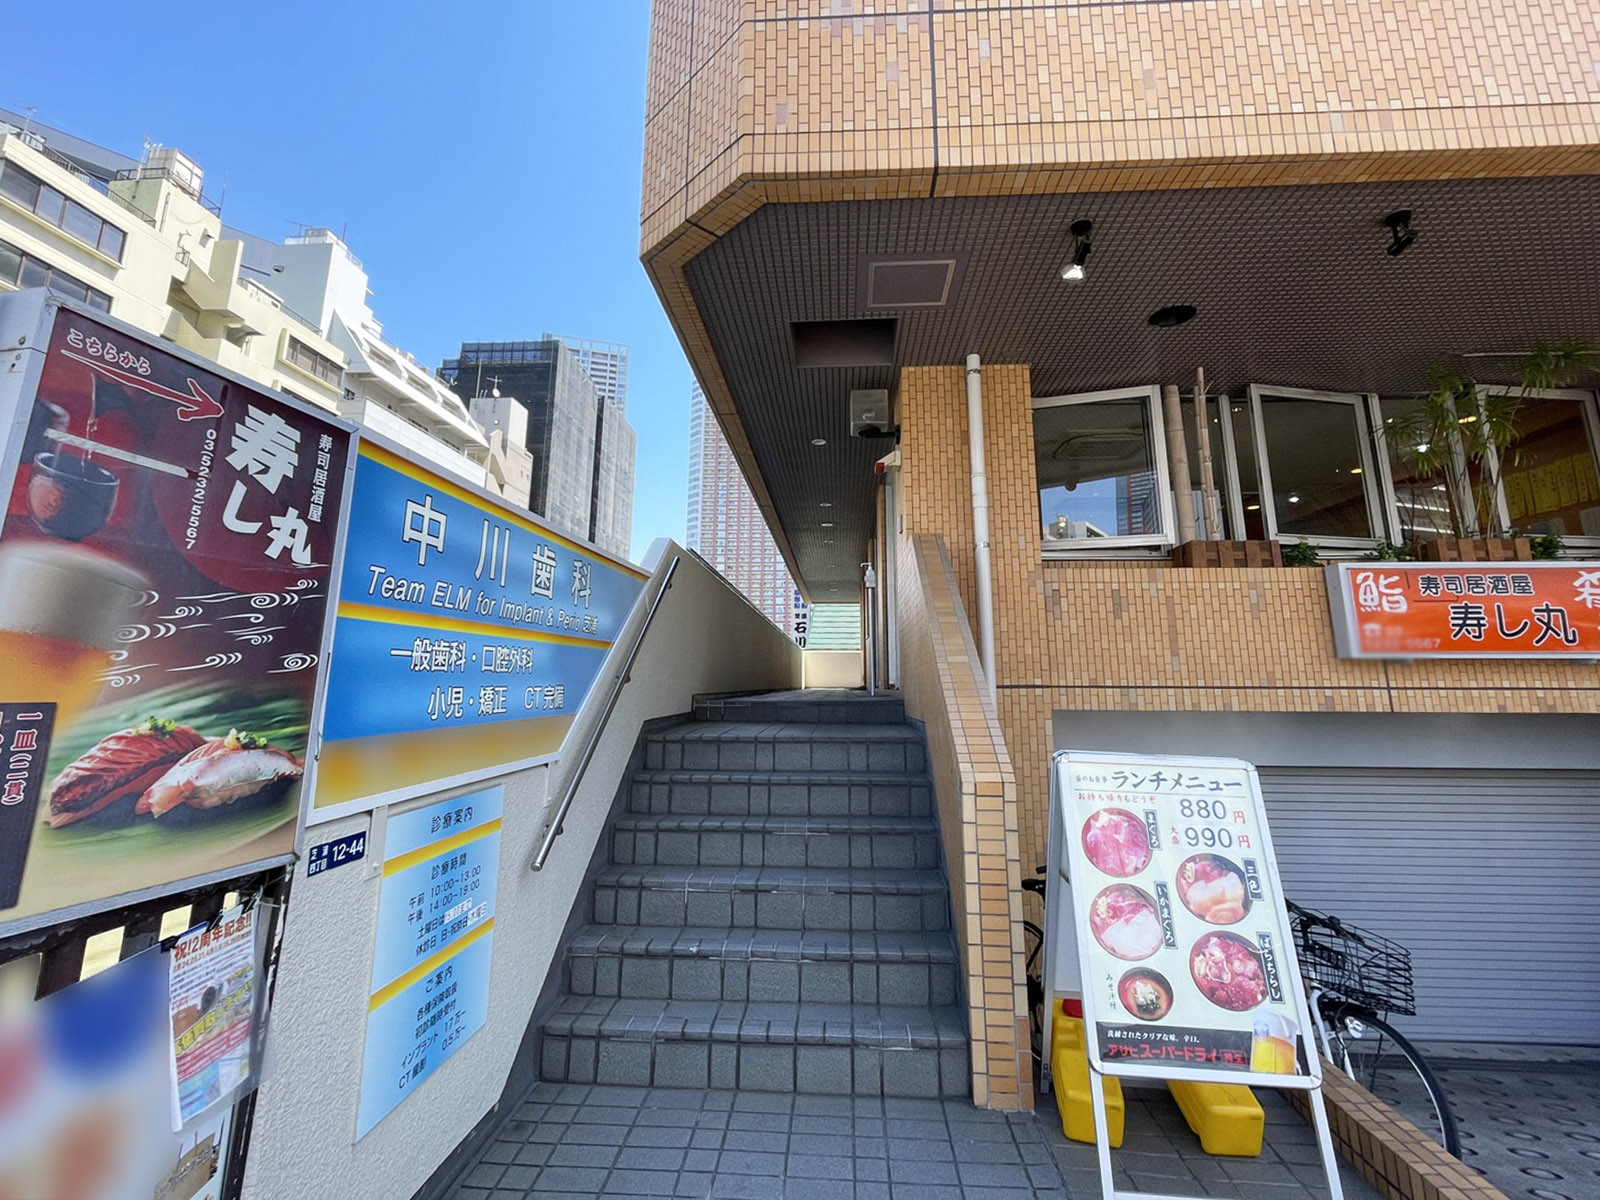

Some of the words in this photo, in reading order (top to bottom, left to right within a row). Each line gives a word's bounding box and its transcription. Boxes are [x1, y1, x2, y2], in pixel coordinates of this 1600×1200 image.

[66, 327, 152, 375] こちらから
[222, 405, 314, 565] 寿し丸
[305, 432, 334, 524] 寿司居酒屋
[400, 493, 594, 610] 中川歯科
[367, 564, 428, 606] Team
[430, 581, 474, 611] ELM
[475, 590, 497, 617] for
[498, 598, 544, 627] Implant
[545, 610, 555, 627] &
[557, 609, 581, 632] Perio
[1355, 571, 1408, 614] 鮨
[1418, 574, 1535, 596] 寿司居酒屋
[1447, 600, 1579, 648] 寿し丸
[389, 637, 535, 675] 一般歯科・口腔外科
[426, 684, 509, 721] 小児・矯正
[1111, 769, 1243, 793] ランチメニュー
[1077, 791, 1157, 805] お持ち帰りもどうぞ
[1179, 797, 1228, 821] 880
[1233, 810, 1247, 825] 円
[430, 805, 474, 834] 診療案内
[1146, 811, 1160, 849] まぐろ
[332, 836, 365, 863] 12-44
[1184, 826, 1233, 849] 990
[1237, 834, 1252, 849] 円
[430, 852, 468, 881] 診療時間
[407, 908, 424, 926] 午後
[408, 892, 426, 909] 午前
[1156, 885, 1175, 945] いかまぐろ
[424, 964, 454, 994] ご案内
[400, 1030, 440, 1070] インプラント
[1107, 1043, 1219, 1064] アサヒスーパードライ
